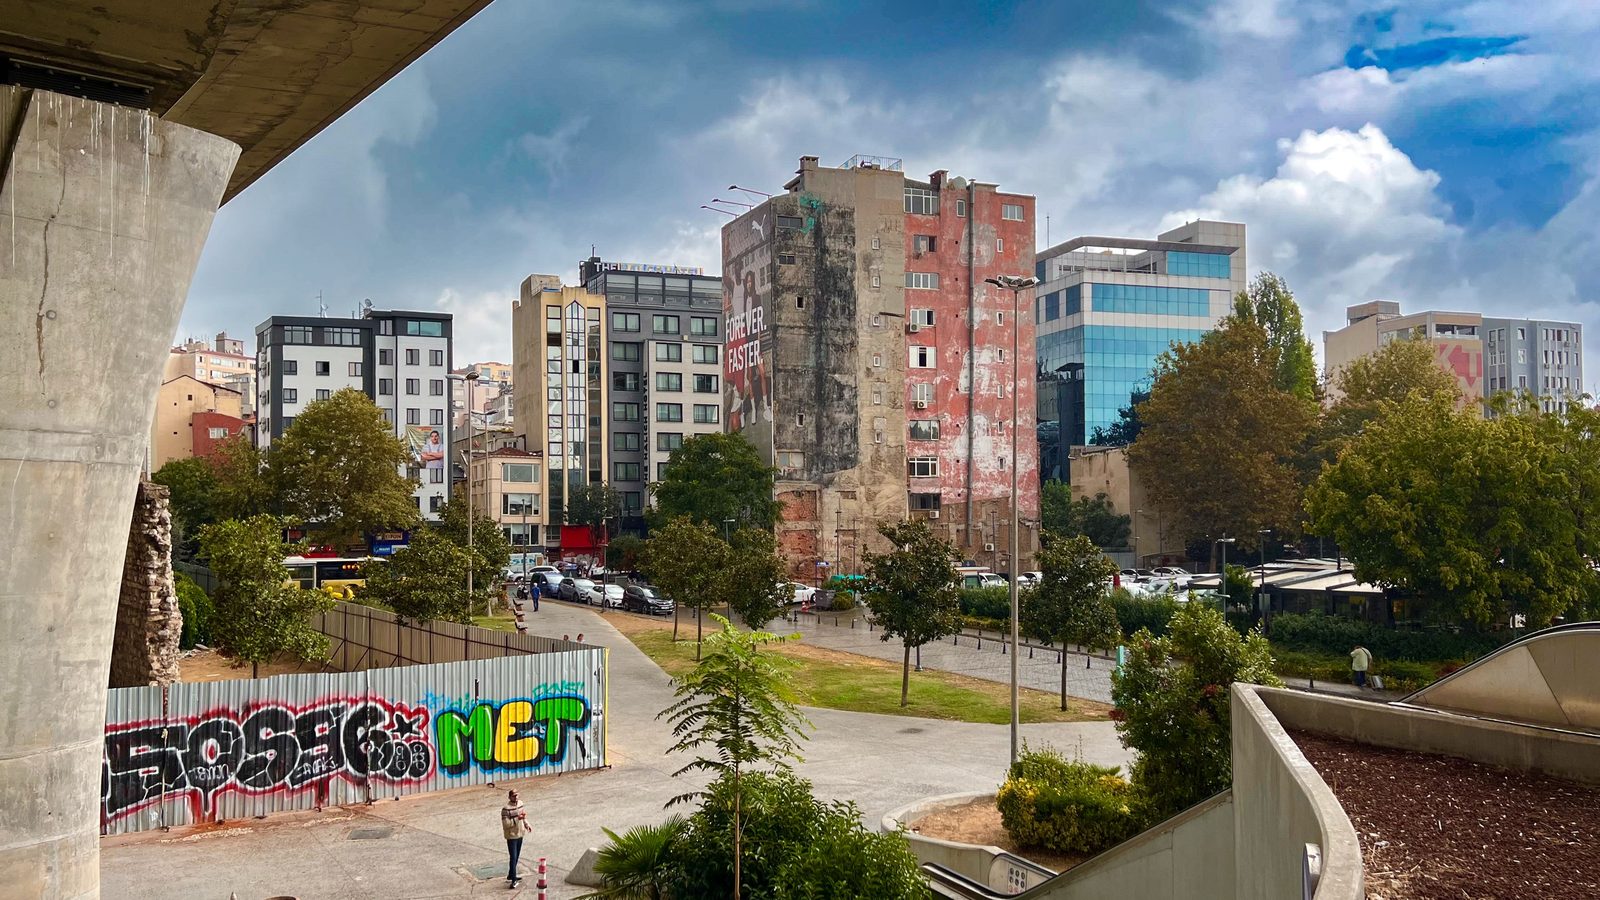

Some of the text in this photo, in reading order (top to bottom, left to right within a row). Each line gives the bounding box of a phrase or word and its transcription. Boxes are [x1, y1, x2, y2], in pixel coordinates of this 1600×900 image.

[725, 306, 767, 344] FOREVER.
[728, 340, 764, 374] FASTER.
[435, 695, 592, 776] MET
